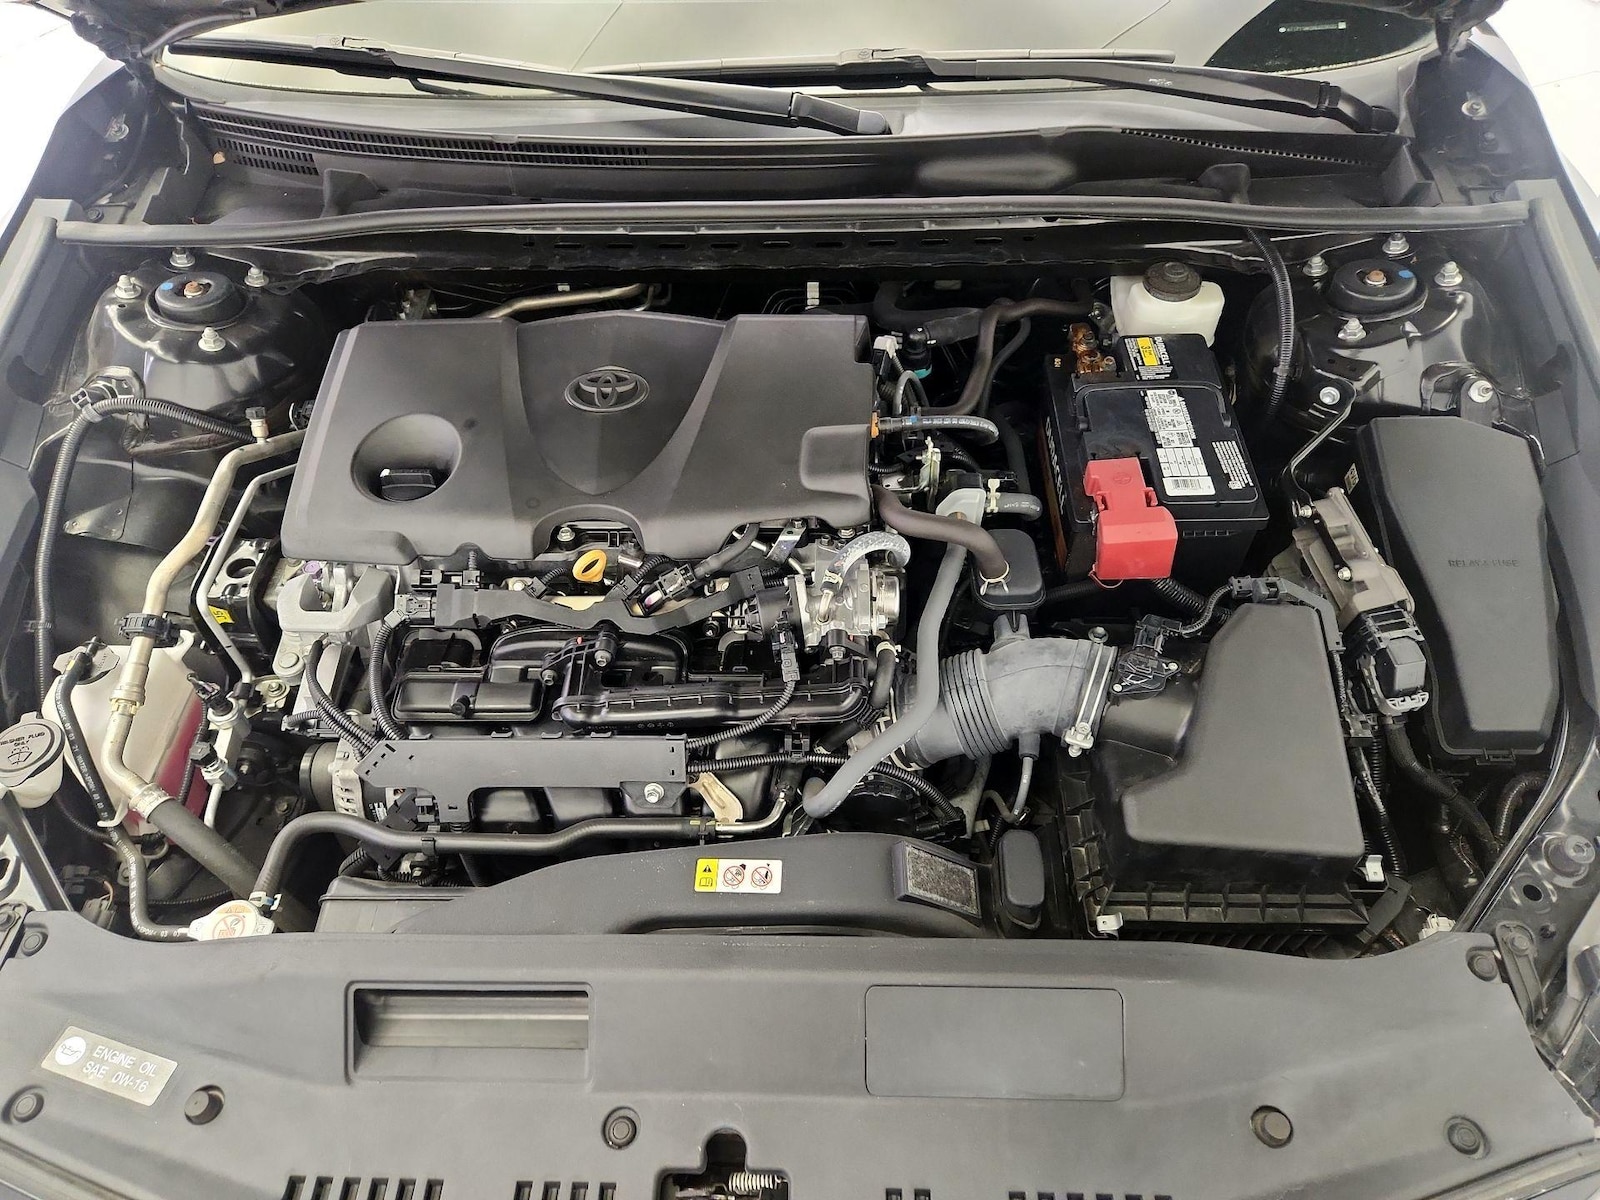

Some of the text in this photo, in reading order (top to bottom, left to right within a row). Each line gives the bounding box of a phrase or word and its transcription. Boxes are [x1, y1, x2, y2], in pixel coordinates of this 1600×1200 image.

[1154, 336, 1171, 365] DURACELL
[1046, 416, 1065, 515] DURACELL
[1447, 559, 1479, 568] RELAY
[1491, 559, 1520, 568] FUSE
[76, 754, 88, 774] WATER
[93, 1045, 157, 1077] ENGINE OIL
[82, 1060, 149, 1093] SAE 0W-16
